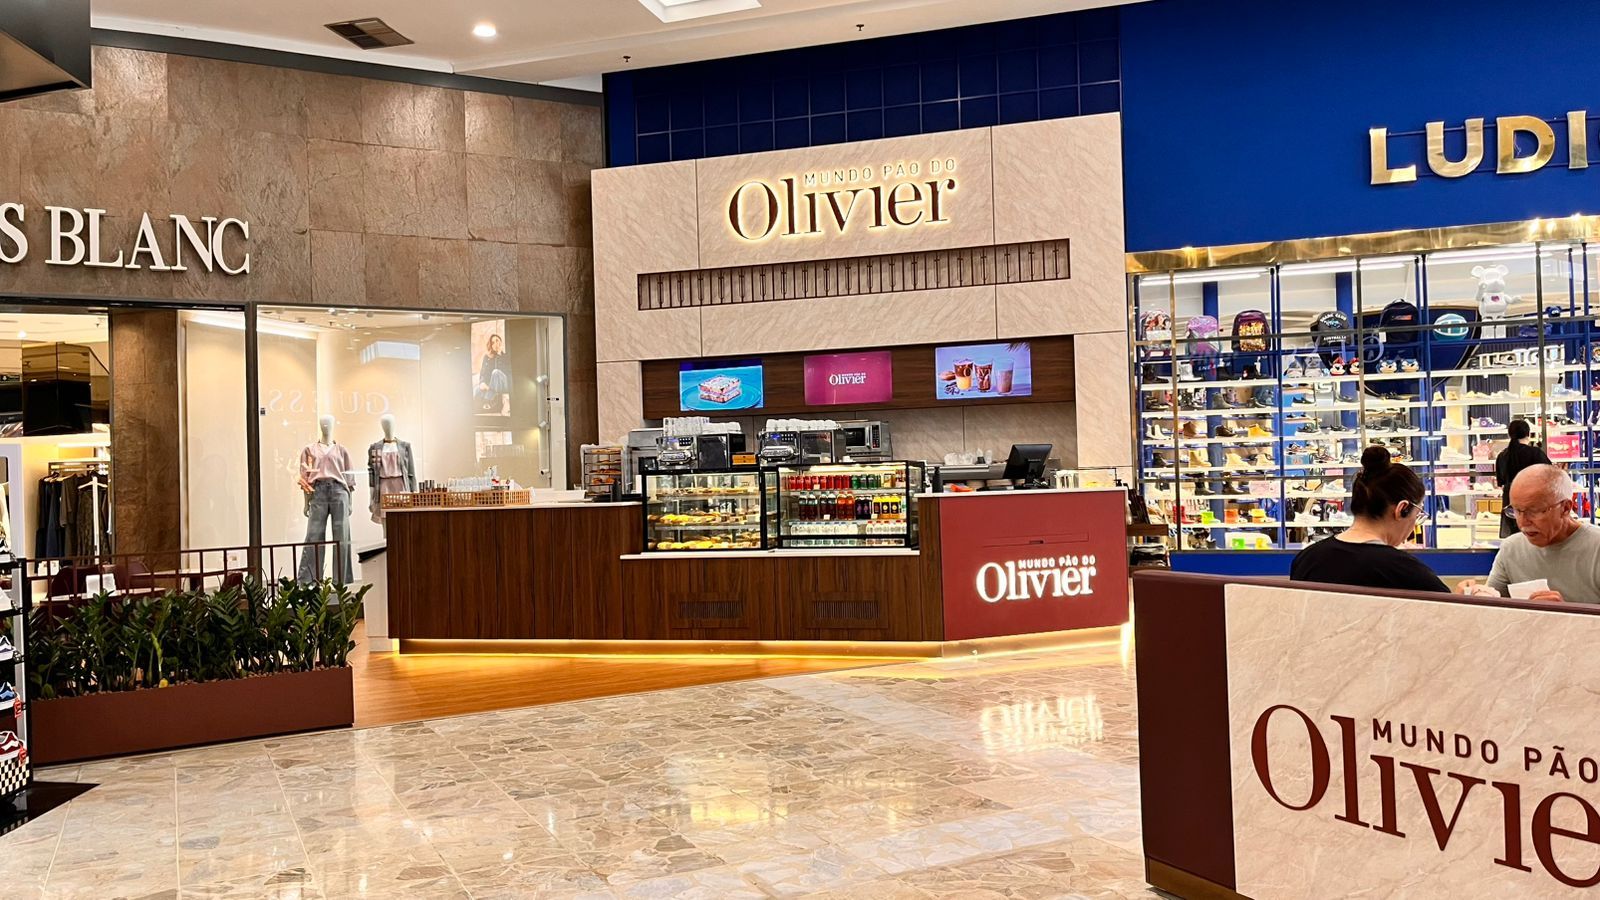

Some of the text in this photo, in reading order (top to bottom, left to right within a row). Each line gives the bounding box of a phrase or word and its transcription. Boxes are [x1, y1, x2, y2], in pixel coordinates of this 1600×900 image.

[804, 167, 872, 186] MUNDO
[931, 159, 955, 173] DO
[1369, 110, 1589, 185] LUDI
[729, 178, 956, 240] Olivier
[45, 205, 250, 275] BLANC
[829, 373, 866, 386] Olivier
[976, 561, 1097, 603] Olivier
[1018, 557, 1055, 569] MUNDO
[1082, 554, 1096, 566] DO
[1373, 718, 1599, 783] MUNDO PÃO
